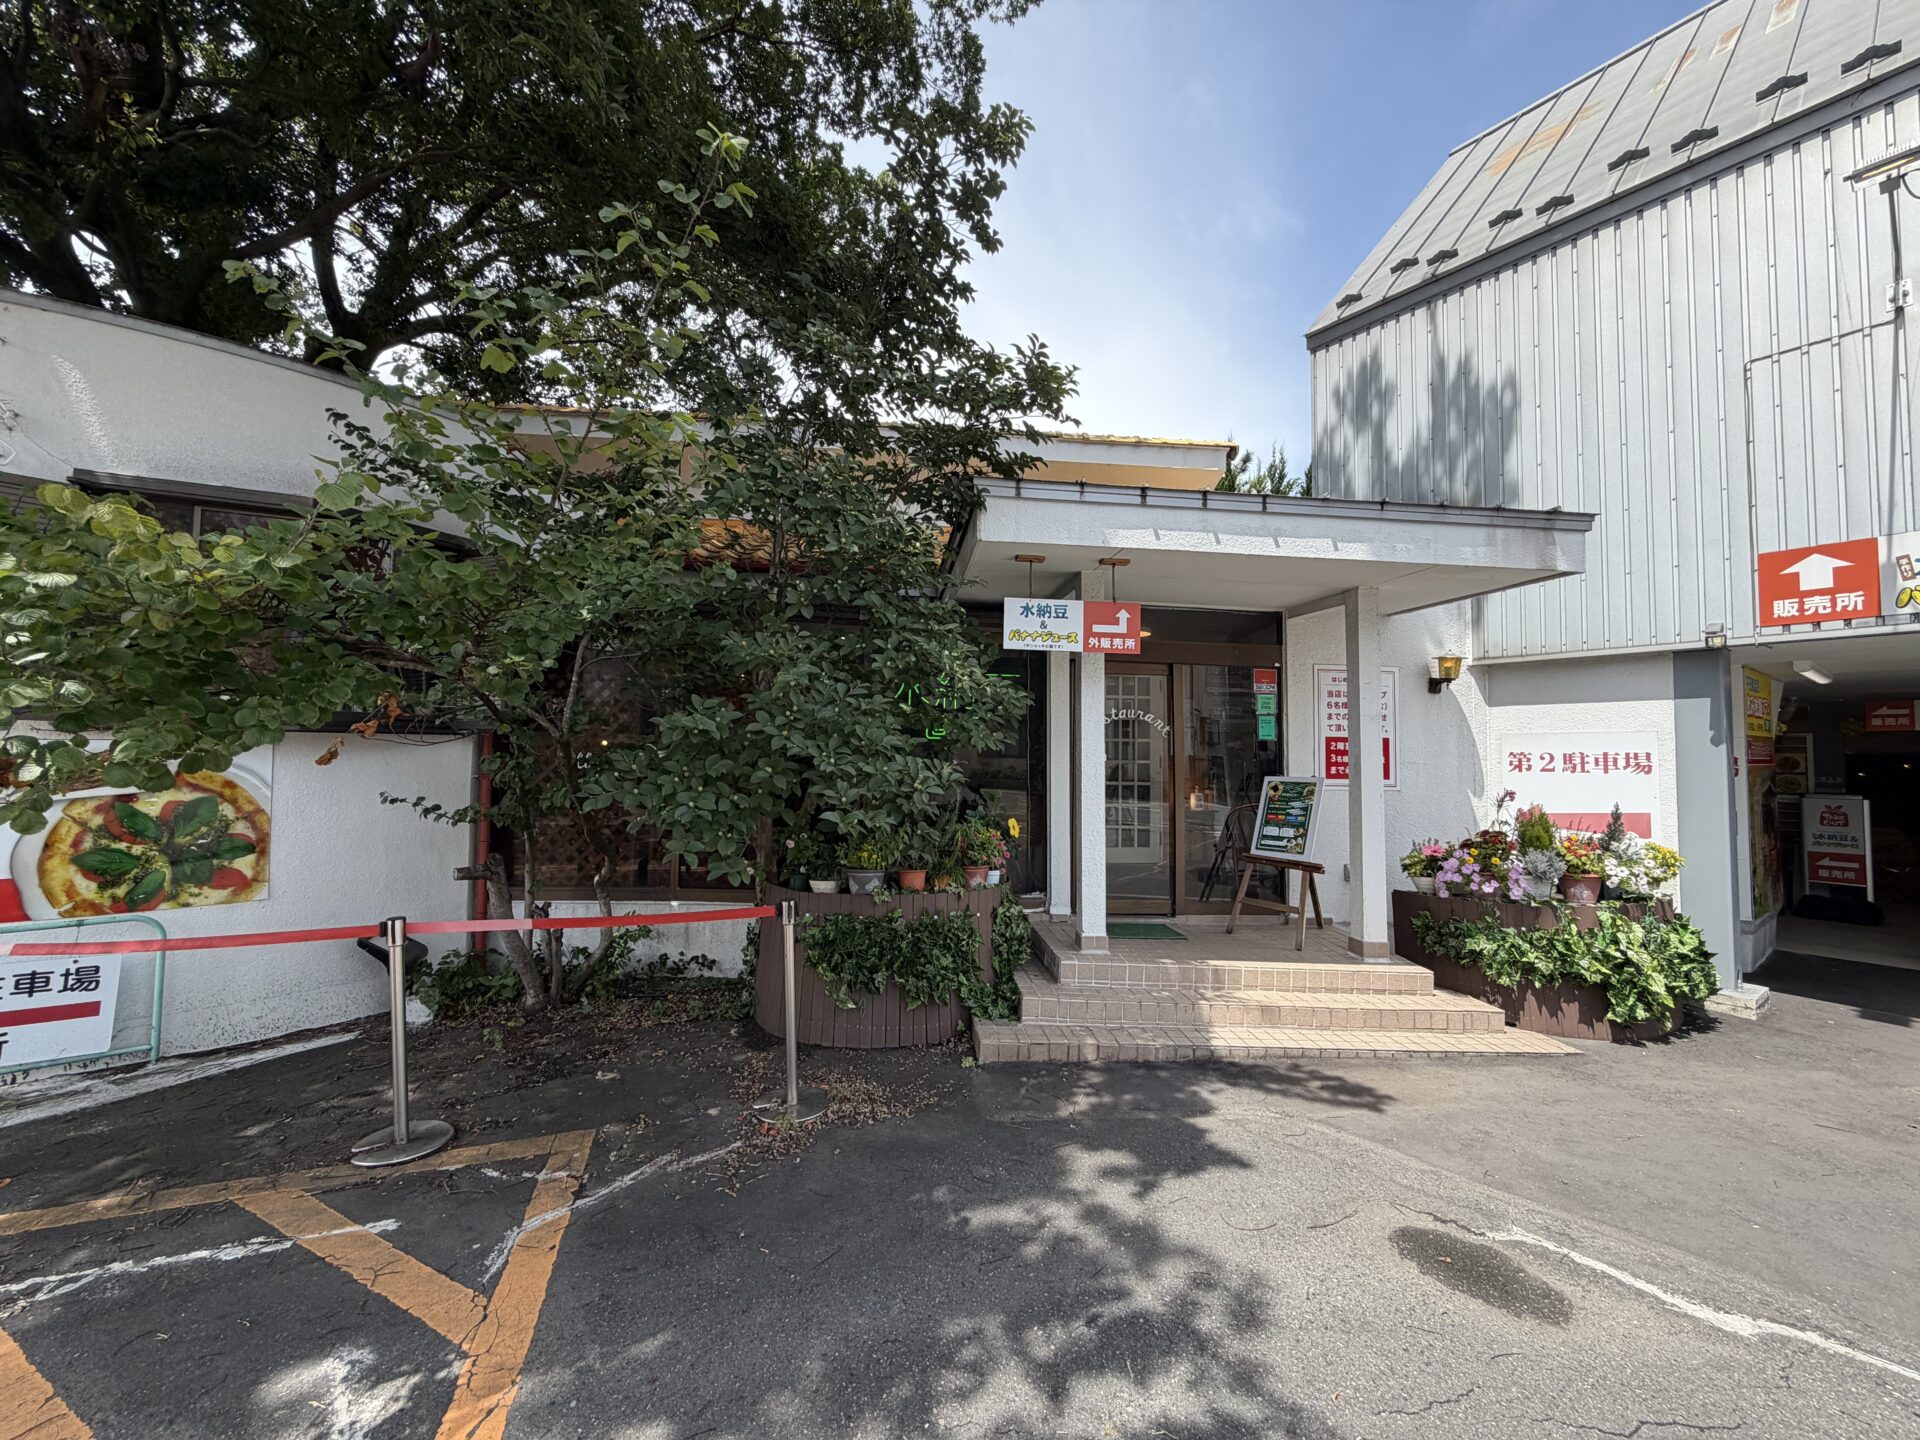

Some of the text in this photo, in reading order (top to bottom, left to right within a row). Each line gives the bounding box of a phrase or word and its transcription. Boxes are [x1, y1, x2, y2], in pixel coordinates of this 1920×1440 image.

[1019, 602, 1069, 619] 水納豆
[1773, 591, 1865, 618] 販売所
[1039, 620, 1048, 630] &
[1008, 629, 1079, 643] バナナジュース
[1088, 637, 1136, 650] 外販売所
[1507, 751, 1654, 775] 第2駐車場
[1822, 813, 1846, 821] TAKE
[0, 965, 102, 998] 車場
